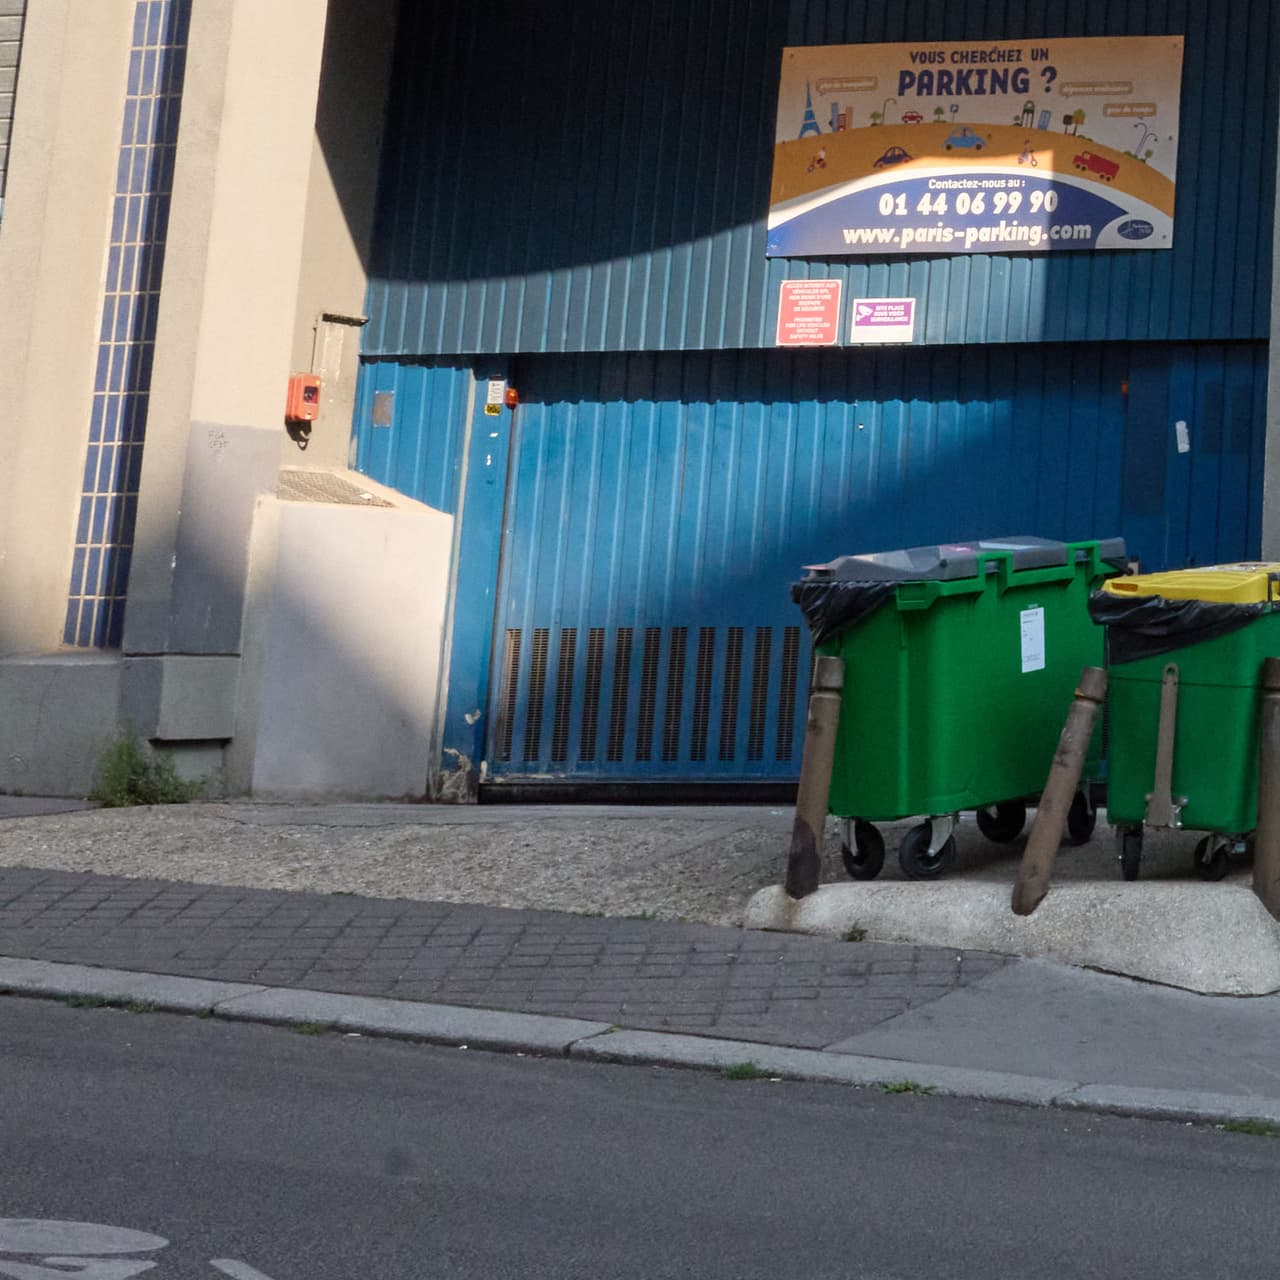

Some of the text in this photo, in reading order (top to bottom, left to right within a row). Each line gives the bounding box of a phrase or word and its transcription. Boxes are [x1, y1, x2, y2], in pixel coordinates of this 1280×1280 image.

[910, 48, 1049, 64] VOUS CHERCHEZ UN
[898, 67, 1030, 97] PARKING
[928, 178, 1006, 189] Contactez-nous
[1007, 179, 1020, 188] au
[879, 189, 1058, 216] 01 44 06 99 90
[843, 221, 1092, 248] www.paris-parking.com
